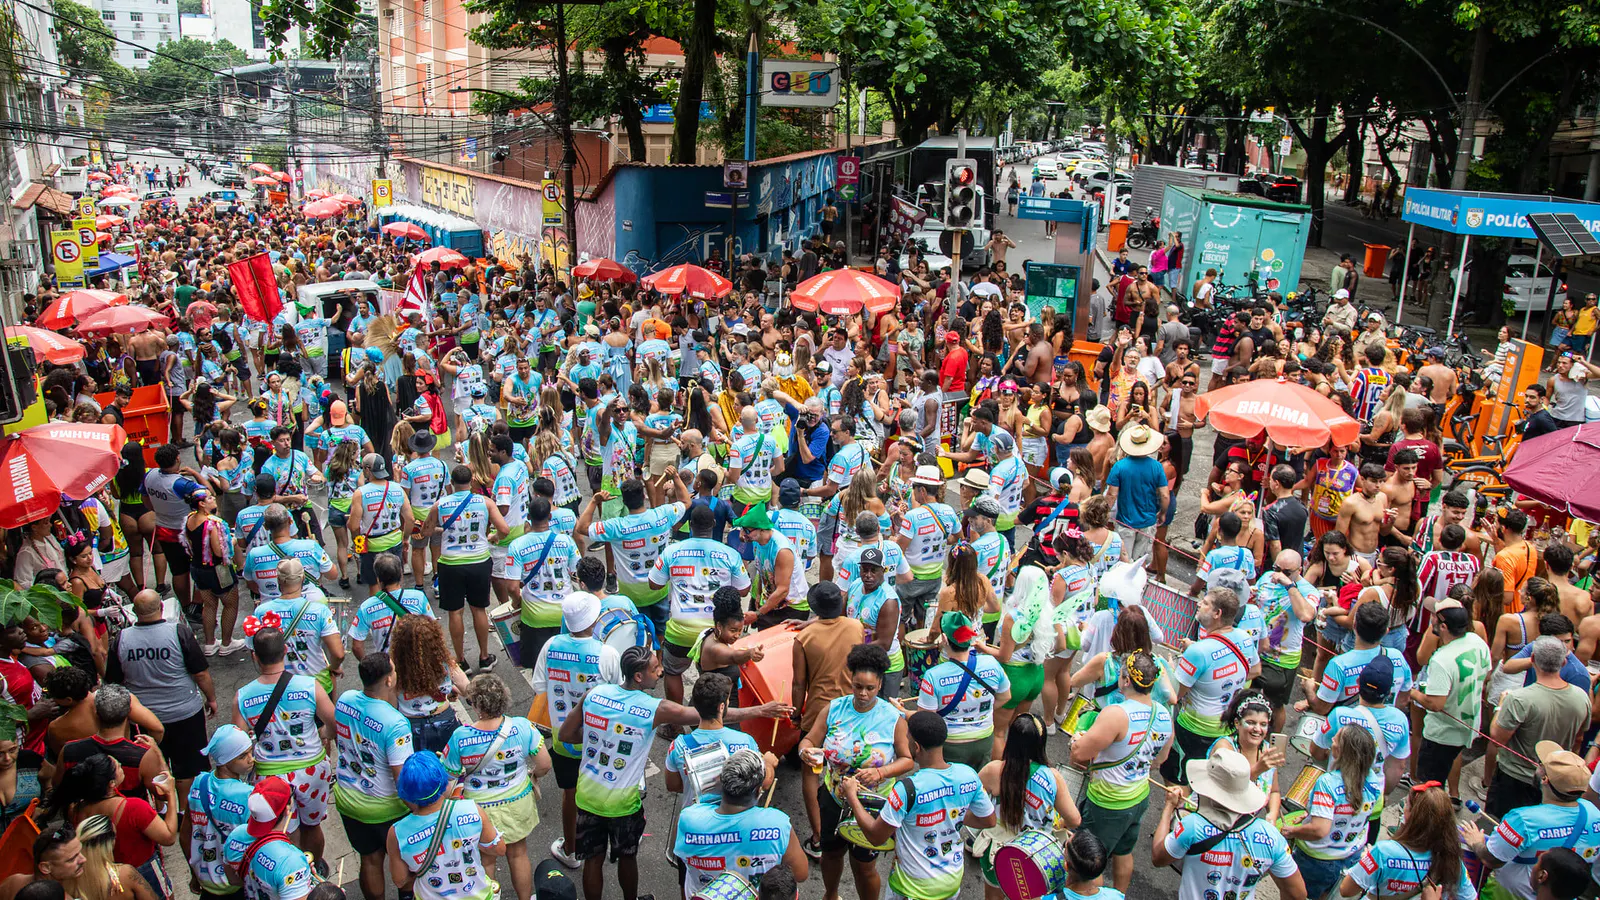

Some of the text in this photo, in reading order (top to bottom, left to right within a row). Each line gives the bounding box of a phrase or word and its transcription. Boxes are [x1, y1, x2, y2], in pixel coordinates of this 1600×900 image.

[774, 74, 826, 89] GET
[1412, 201, 1452, 222] POLÍCIA MILITAR
[1486, 210, 1532, 228] POLÍC
[1236, 401, 1309, 427] BRAHMA
[50, 431, 110, 441] BRAHMA
[9, 453, 34, 502] BRAHMA
[85, 474, 108, 492] BRAHMA
[621, 524, 651, 534] CARNAVAL
[127, 647, 171, 662] APOIO
[586, 656, 600, 664] 202
[1216, 666, 1236, 677] BRAHMA
[288, 692, 309, 700] 2026
[591, 695, 651, 718] CARNAVAL 2026
[365, 718, 383, 732] 2026
[918, 782, 978, 803] CARNAVAL 2026
[220, 800, 244, 814] 2026
[458, 813, 479, 825] 2026
[920, 812, 943, 825] BRAHMA
[685, 829, 779, 844] CARNAVAL 2026
[257, 854, 275, 870] 2026
[690, 857, 722, 869] BRAHMA
[1204, 854, 1231, 864] BRAHMA
[1388, 859, 1432, 870] CARNAVA
[1013, 861, 1028, 897] SPANTA
